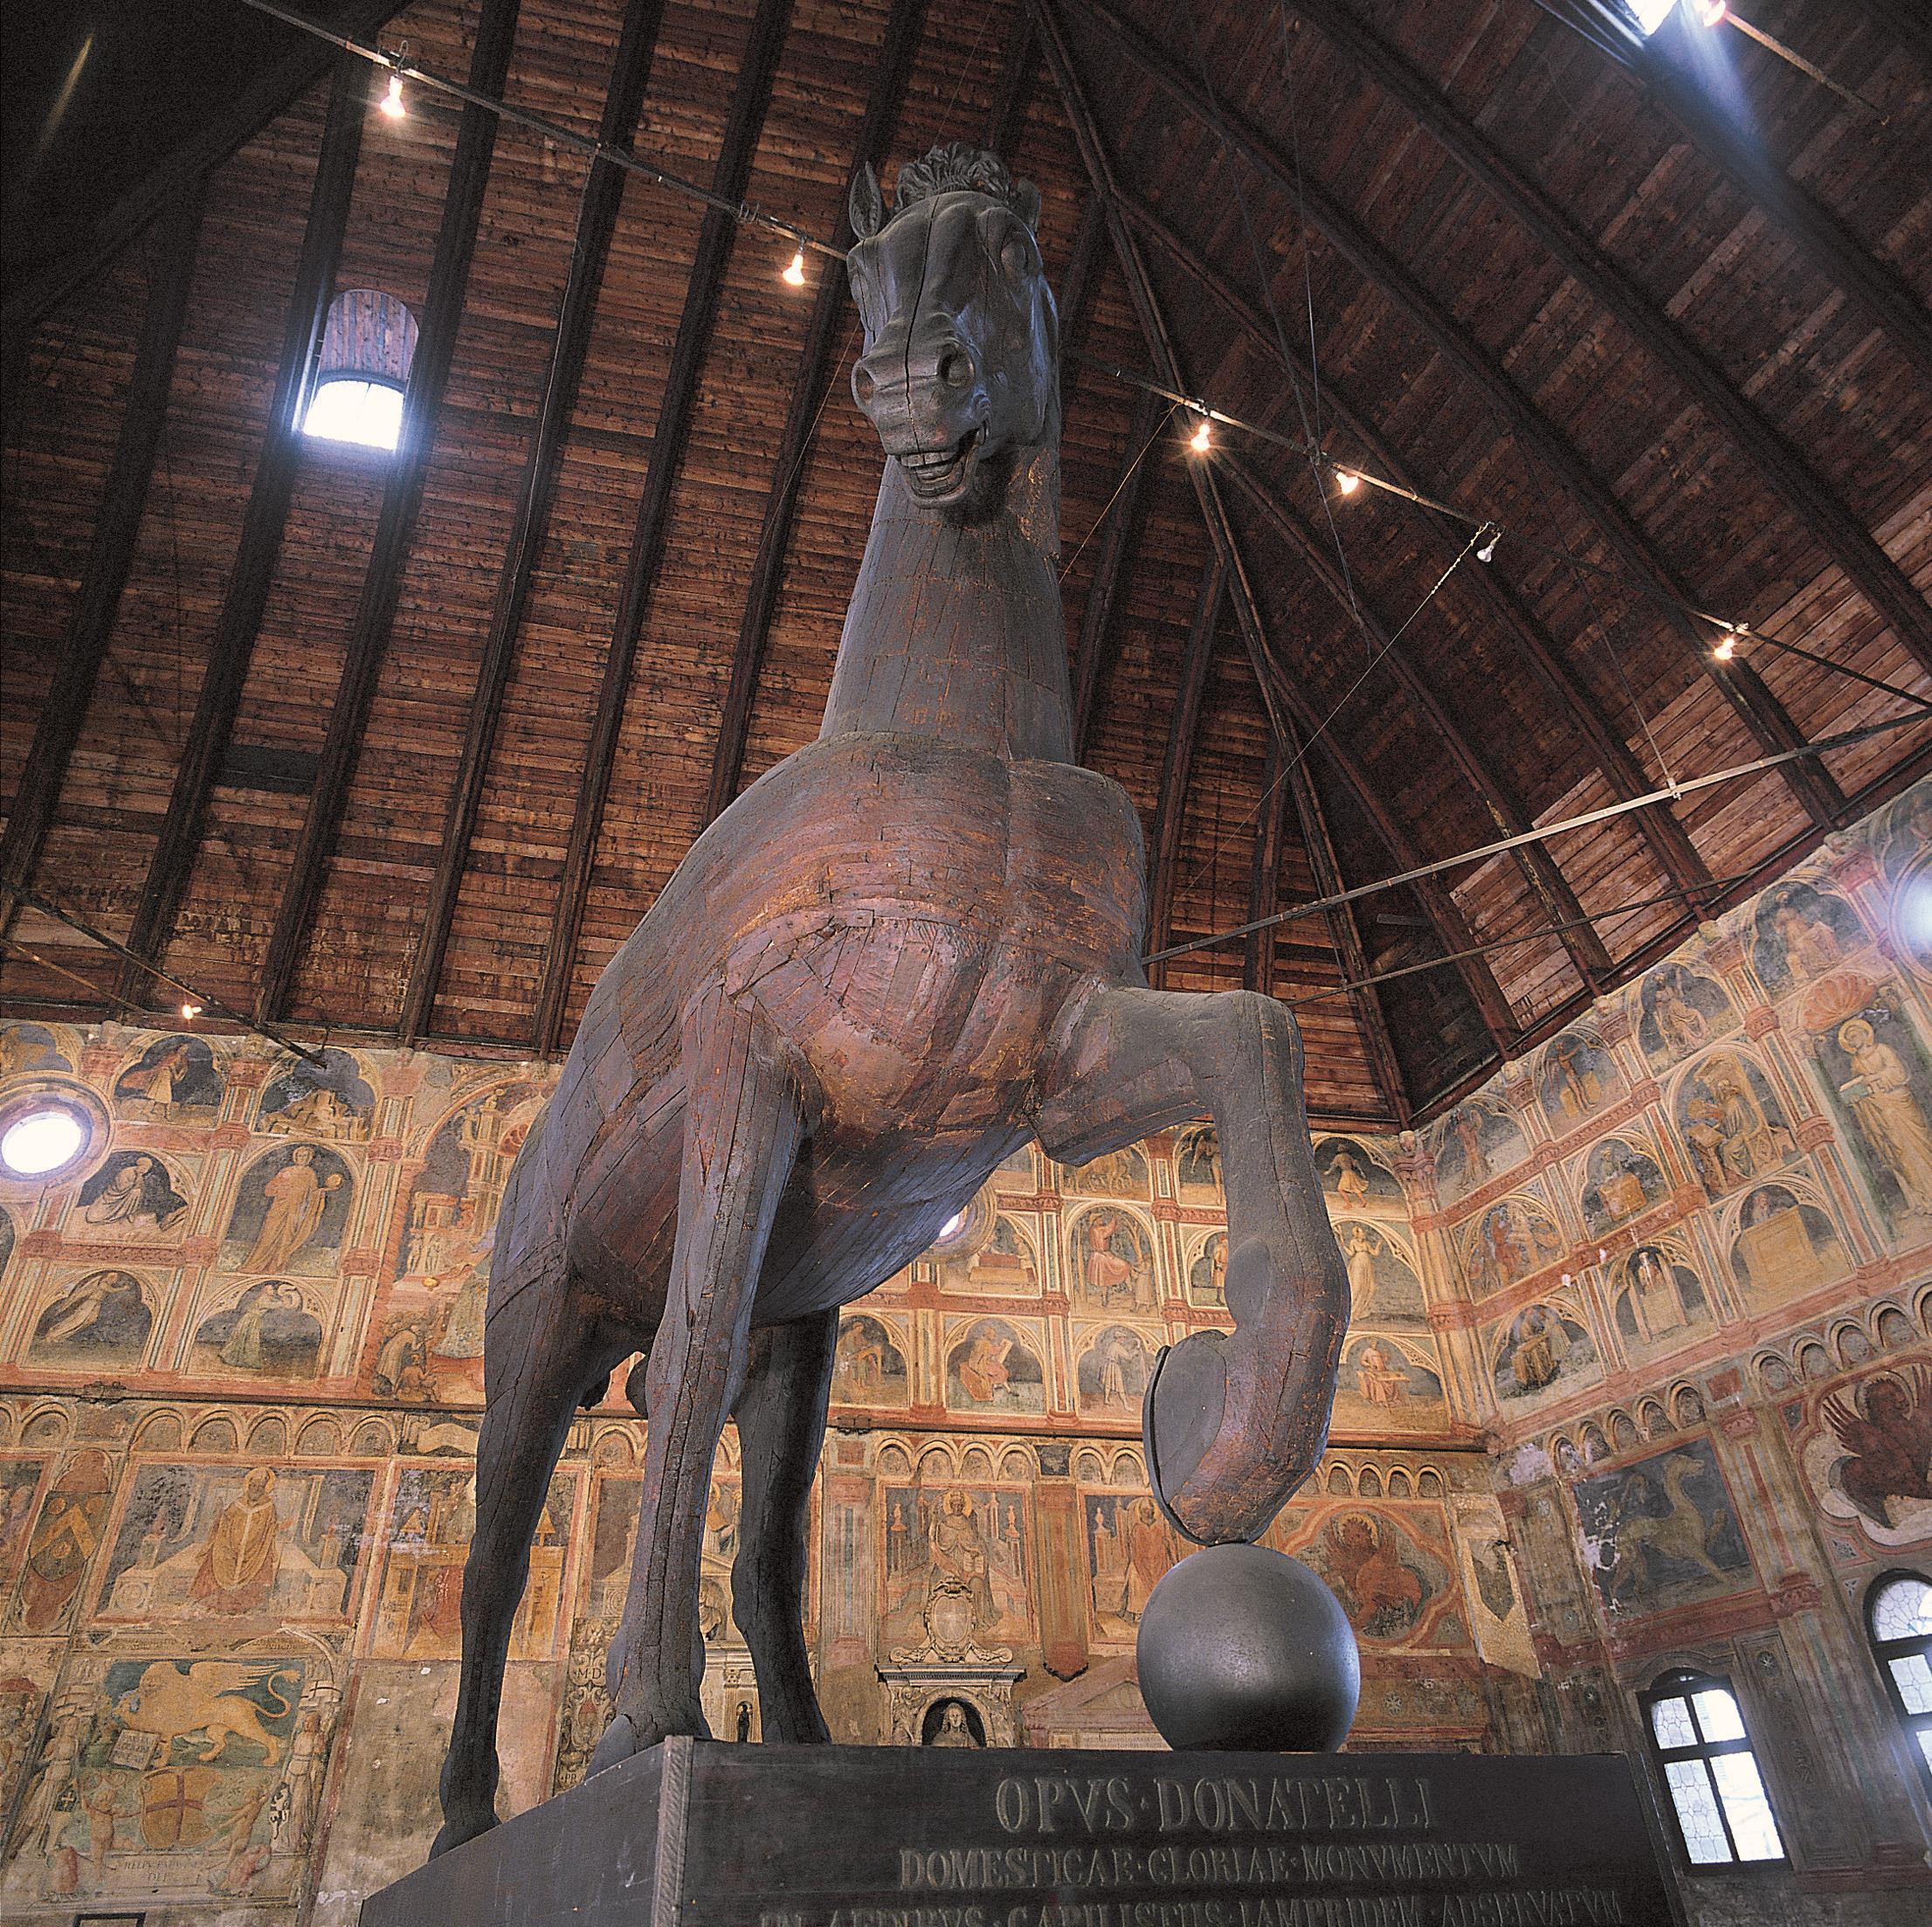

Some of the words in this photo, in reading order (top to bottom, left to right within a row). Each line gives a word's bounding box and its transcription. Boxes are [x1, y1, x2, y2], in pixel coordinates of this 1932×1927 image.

[995, 1777, 1131, 1834] OPVS
[1152, 1776, 1436, 1833] DONATELLI
[898, 1847, 1135, 1891] DOMESTICAE
[1300, 1841, 1521, 1882] MONVMENTVM
